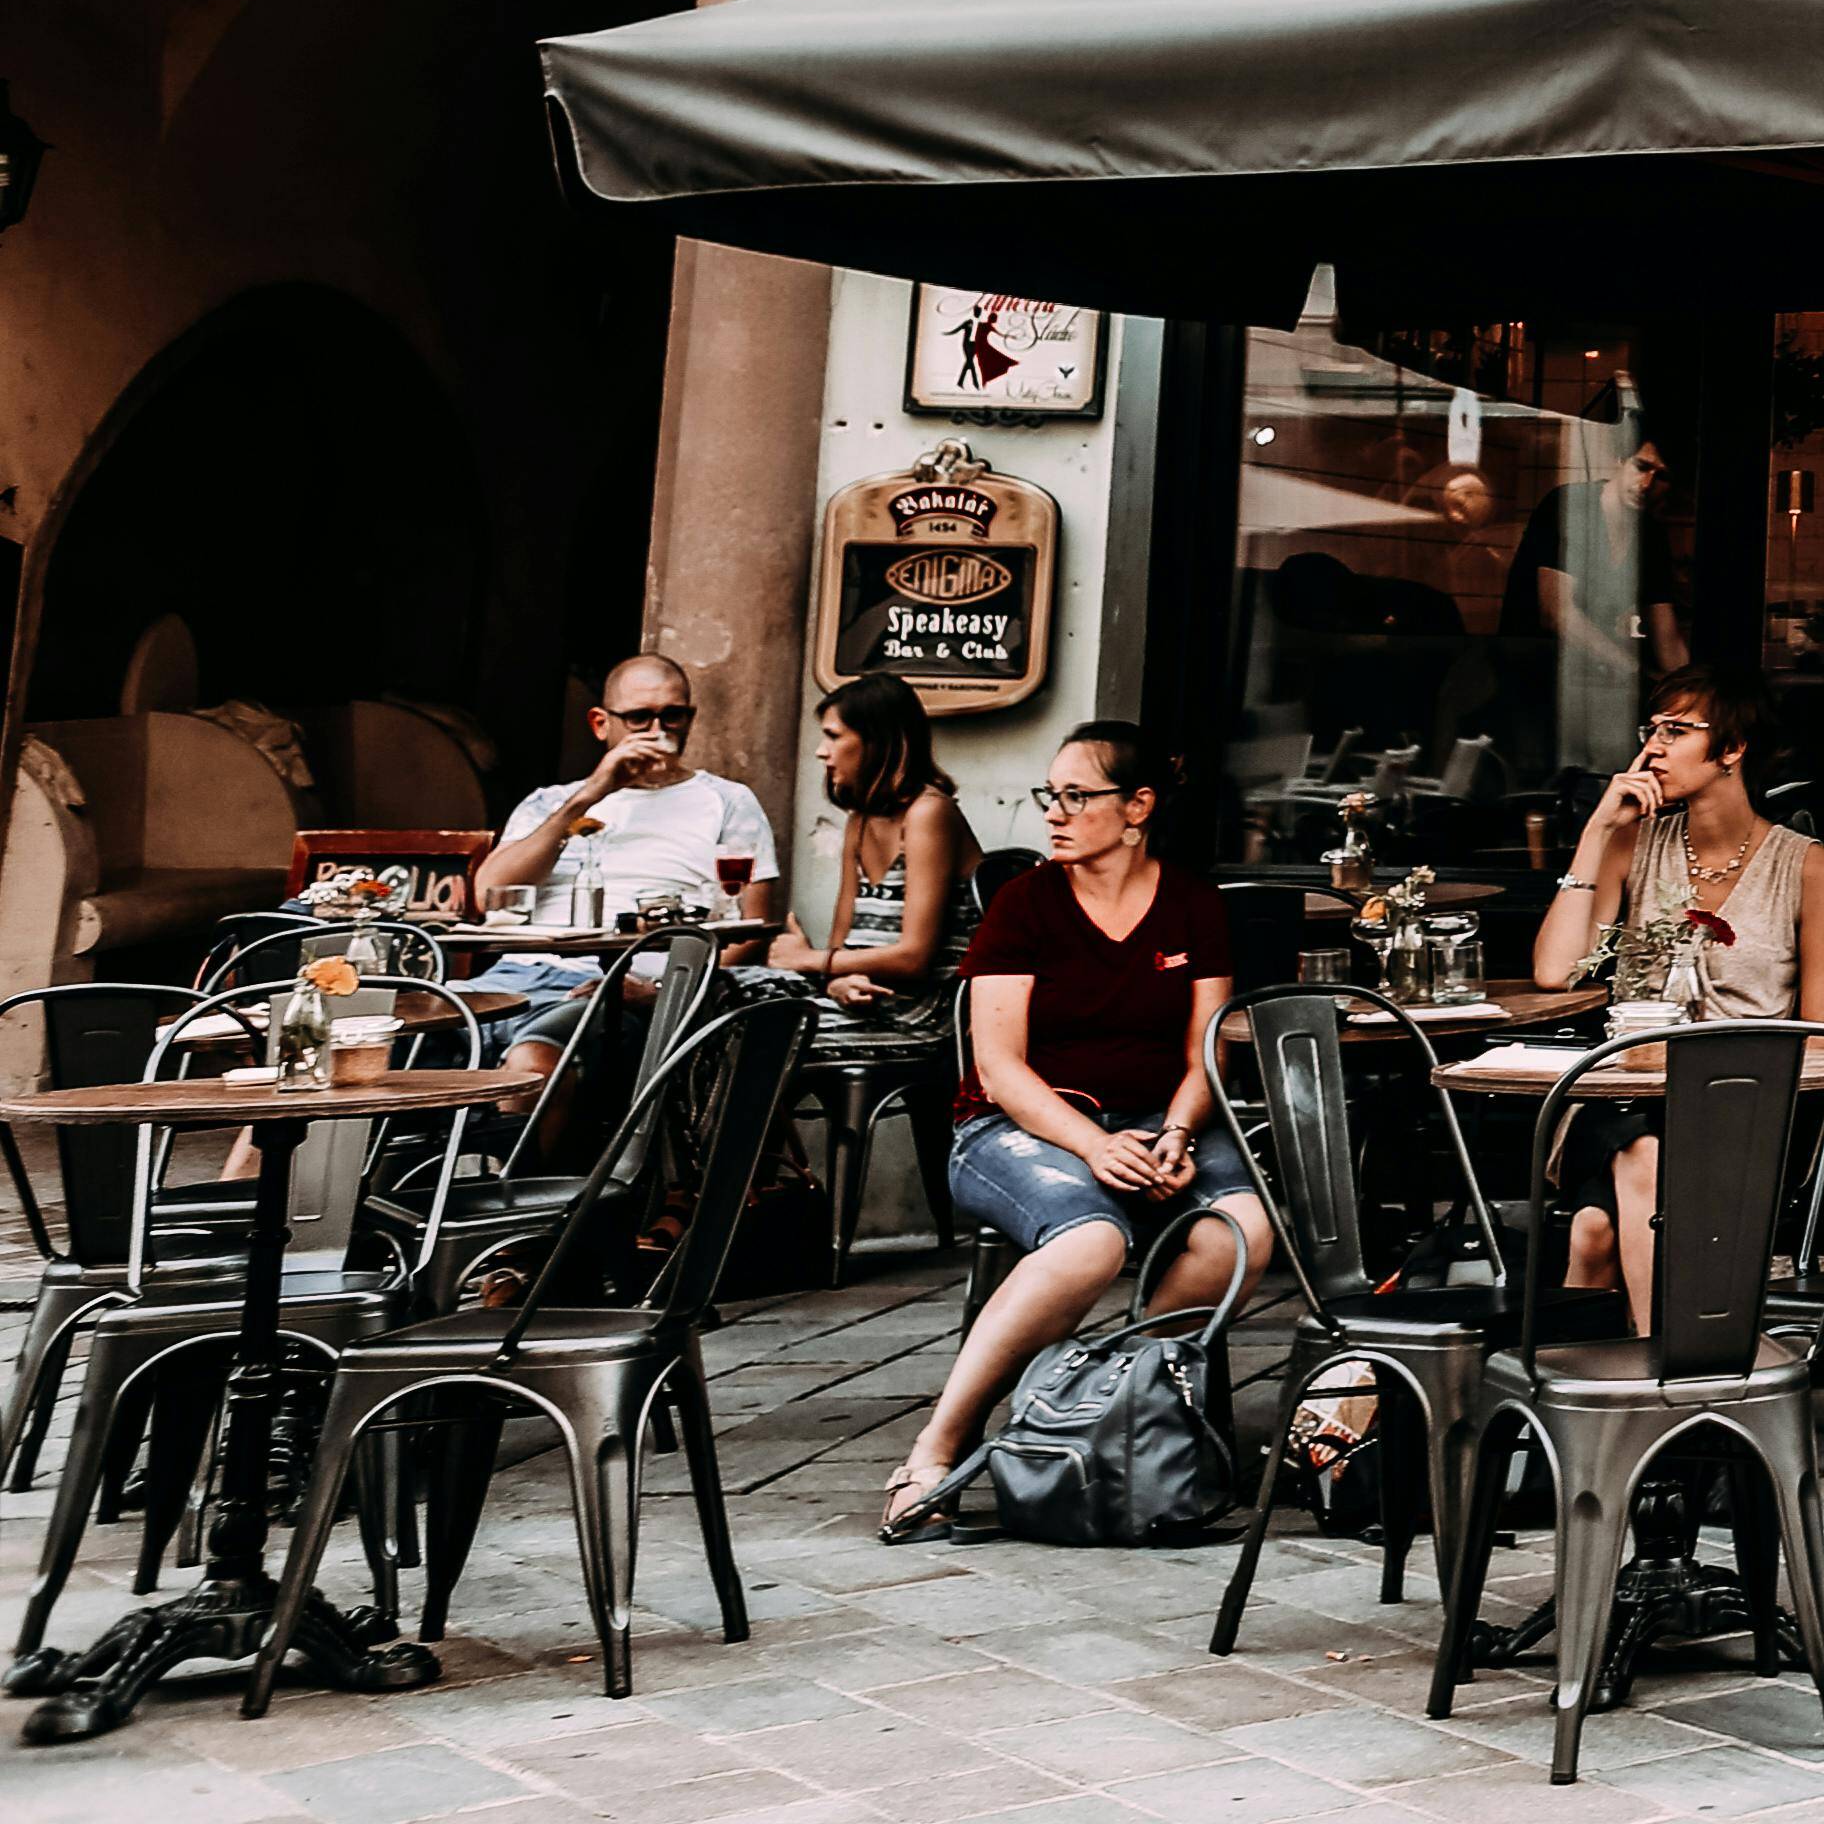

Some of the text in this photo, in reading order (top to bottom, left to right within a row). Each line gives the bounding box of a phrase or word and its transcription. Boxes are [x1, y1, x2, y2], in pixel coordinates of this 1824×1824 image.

[887, 605, 1009, 642] Speakeasy
[883, 639, 1009, 660] Bar & Club
